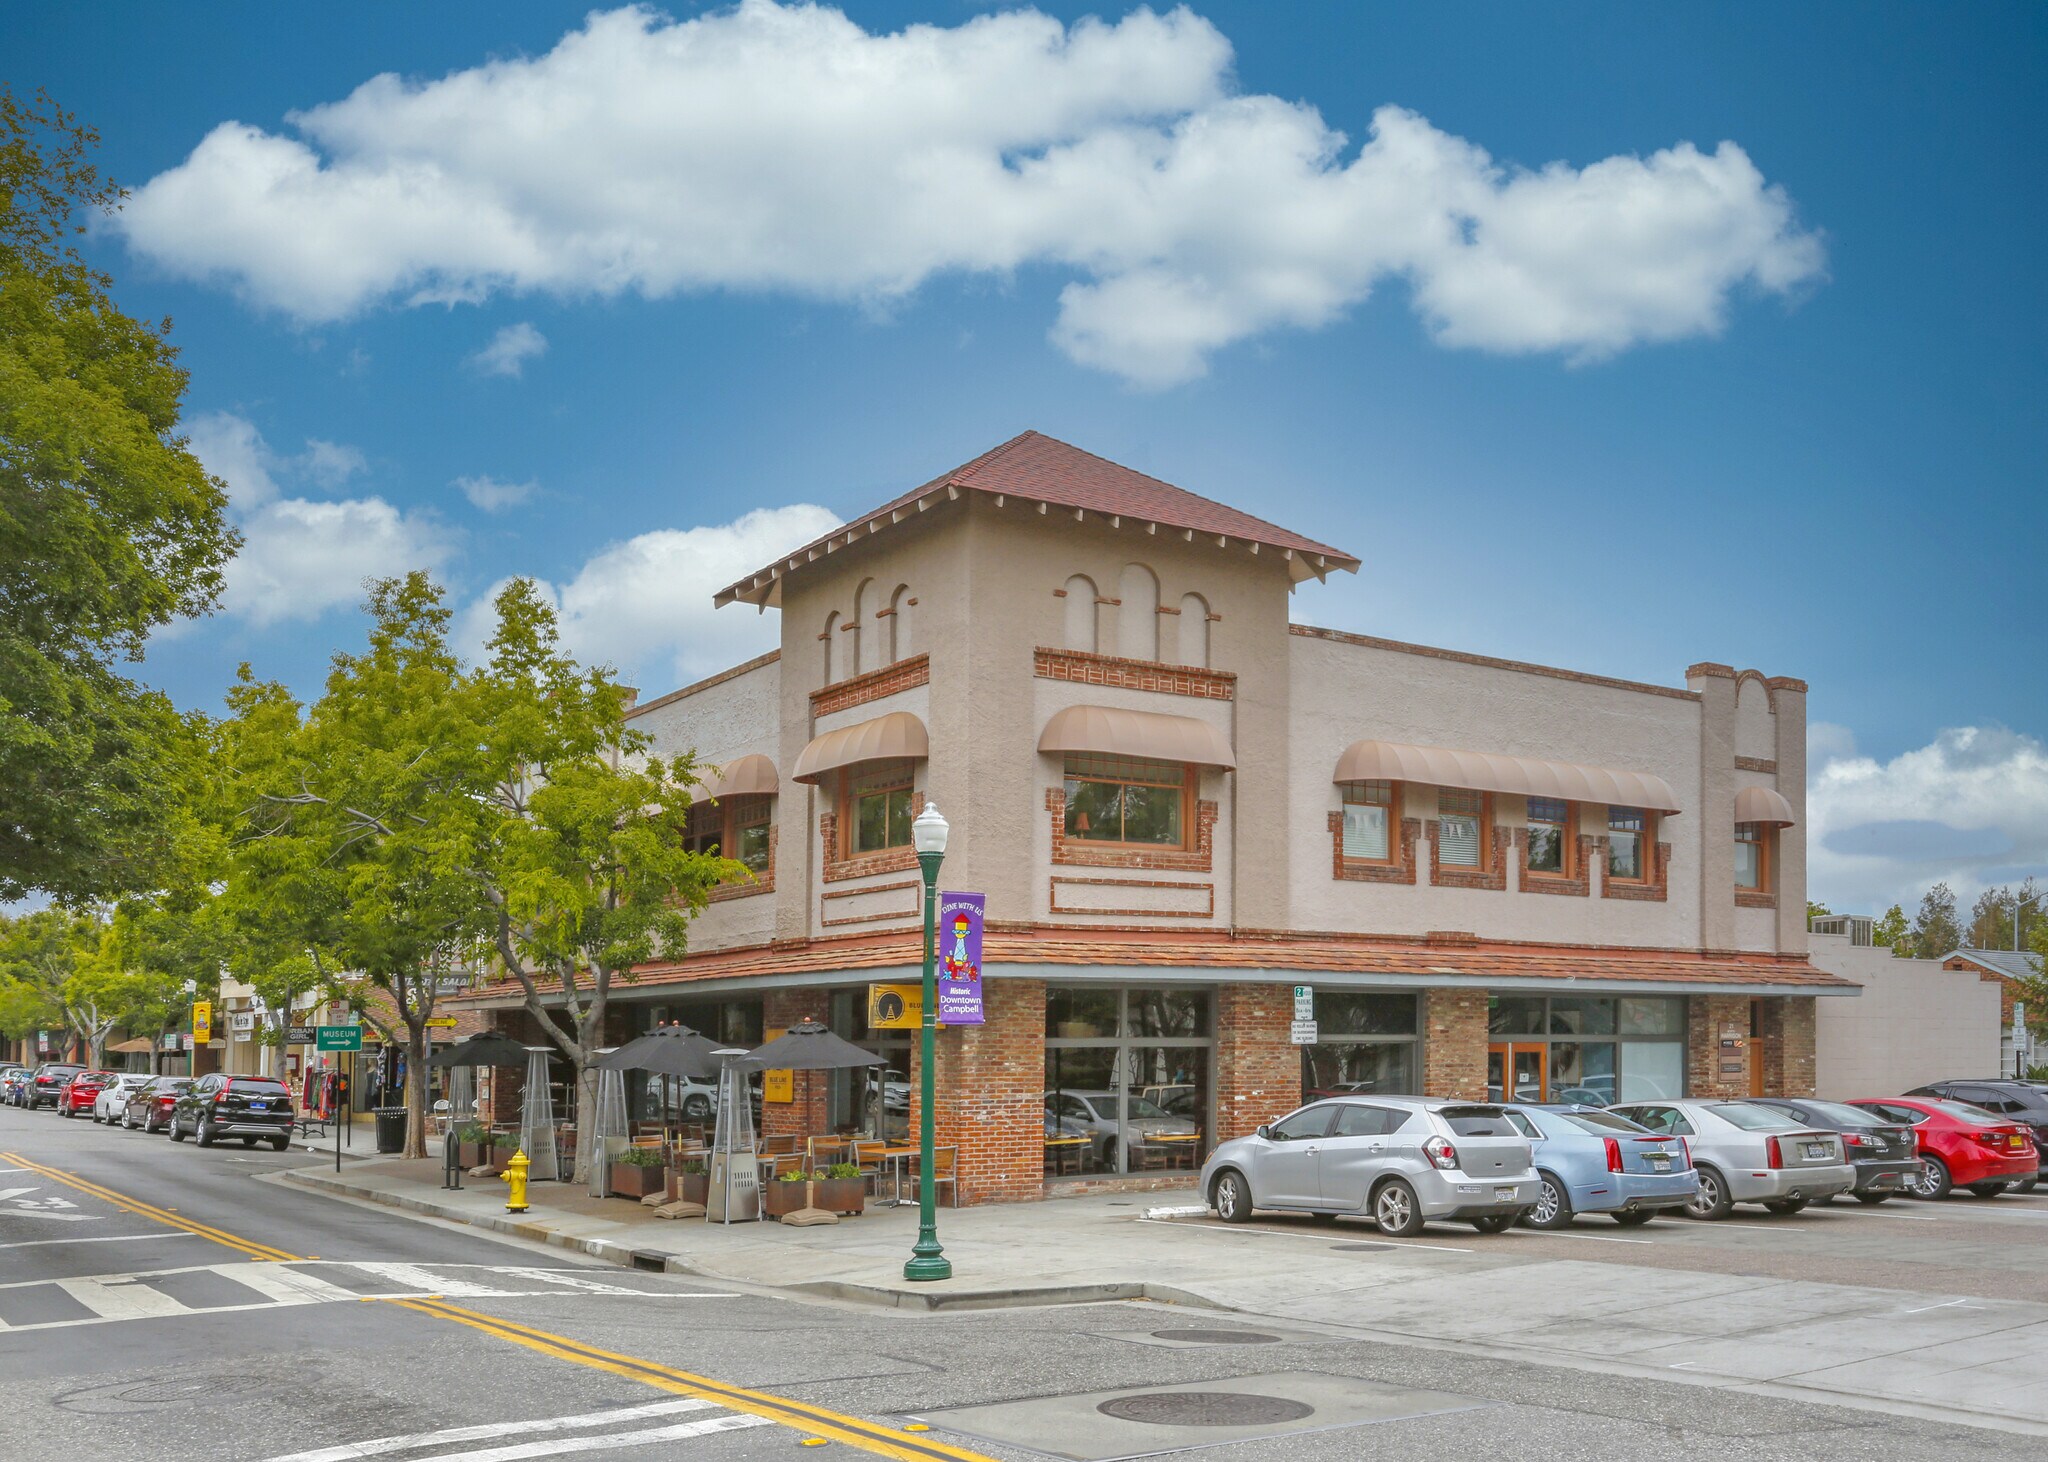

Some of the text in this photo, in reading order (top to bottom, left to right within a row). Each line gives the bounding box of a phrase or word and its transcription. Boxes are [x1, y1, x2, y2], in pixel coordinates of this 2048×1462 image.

[942, 902, 984, 916] DINE WITH US
[940, 995, 981, 1004] Downtown
[943, 1005, 979, 1014] Campbell
